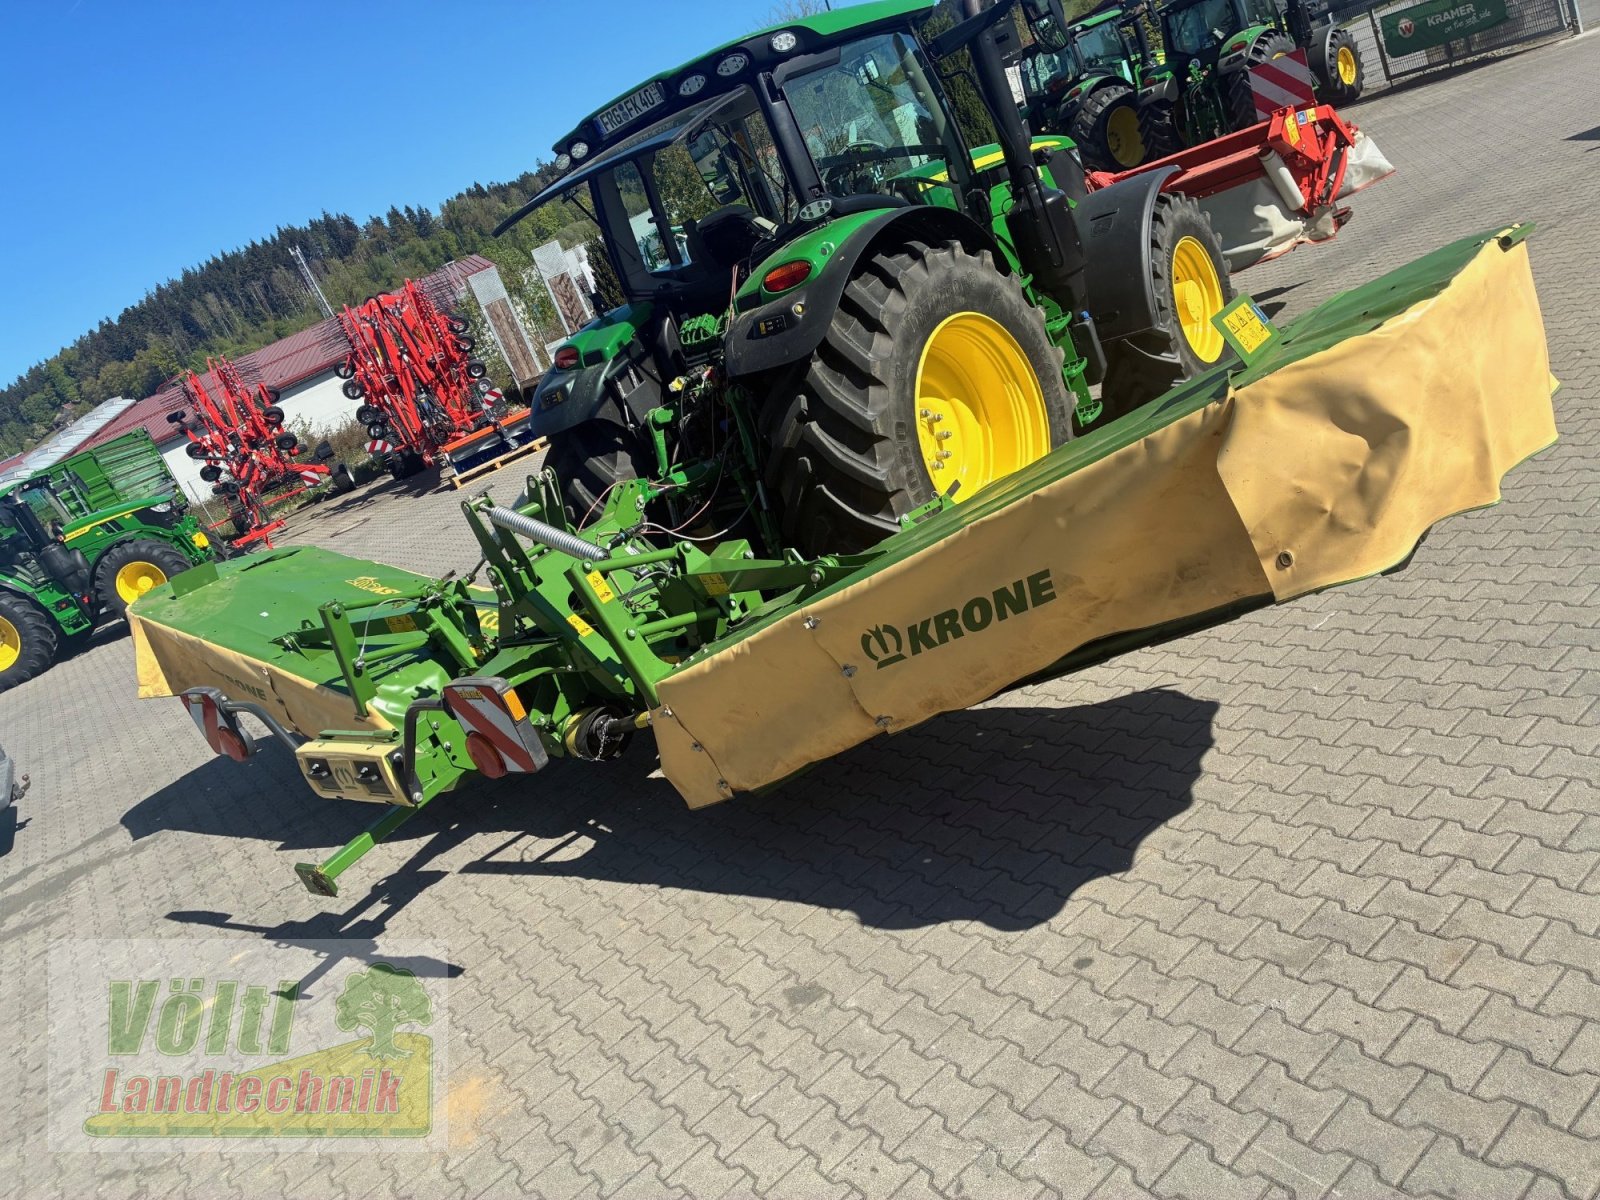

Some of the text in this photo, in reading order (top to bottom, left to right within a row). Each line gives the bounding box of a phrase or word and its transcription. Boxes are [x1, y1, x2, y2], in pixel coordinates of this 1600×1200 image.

[1427, 3, 1475, 27] KRAMER
[600, 107, 622, 132] FRG
[624, 96, 643, 118] FK
[639, 88, 655, 109] 40
[907, 568, 1058, 657] KRONE
